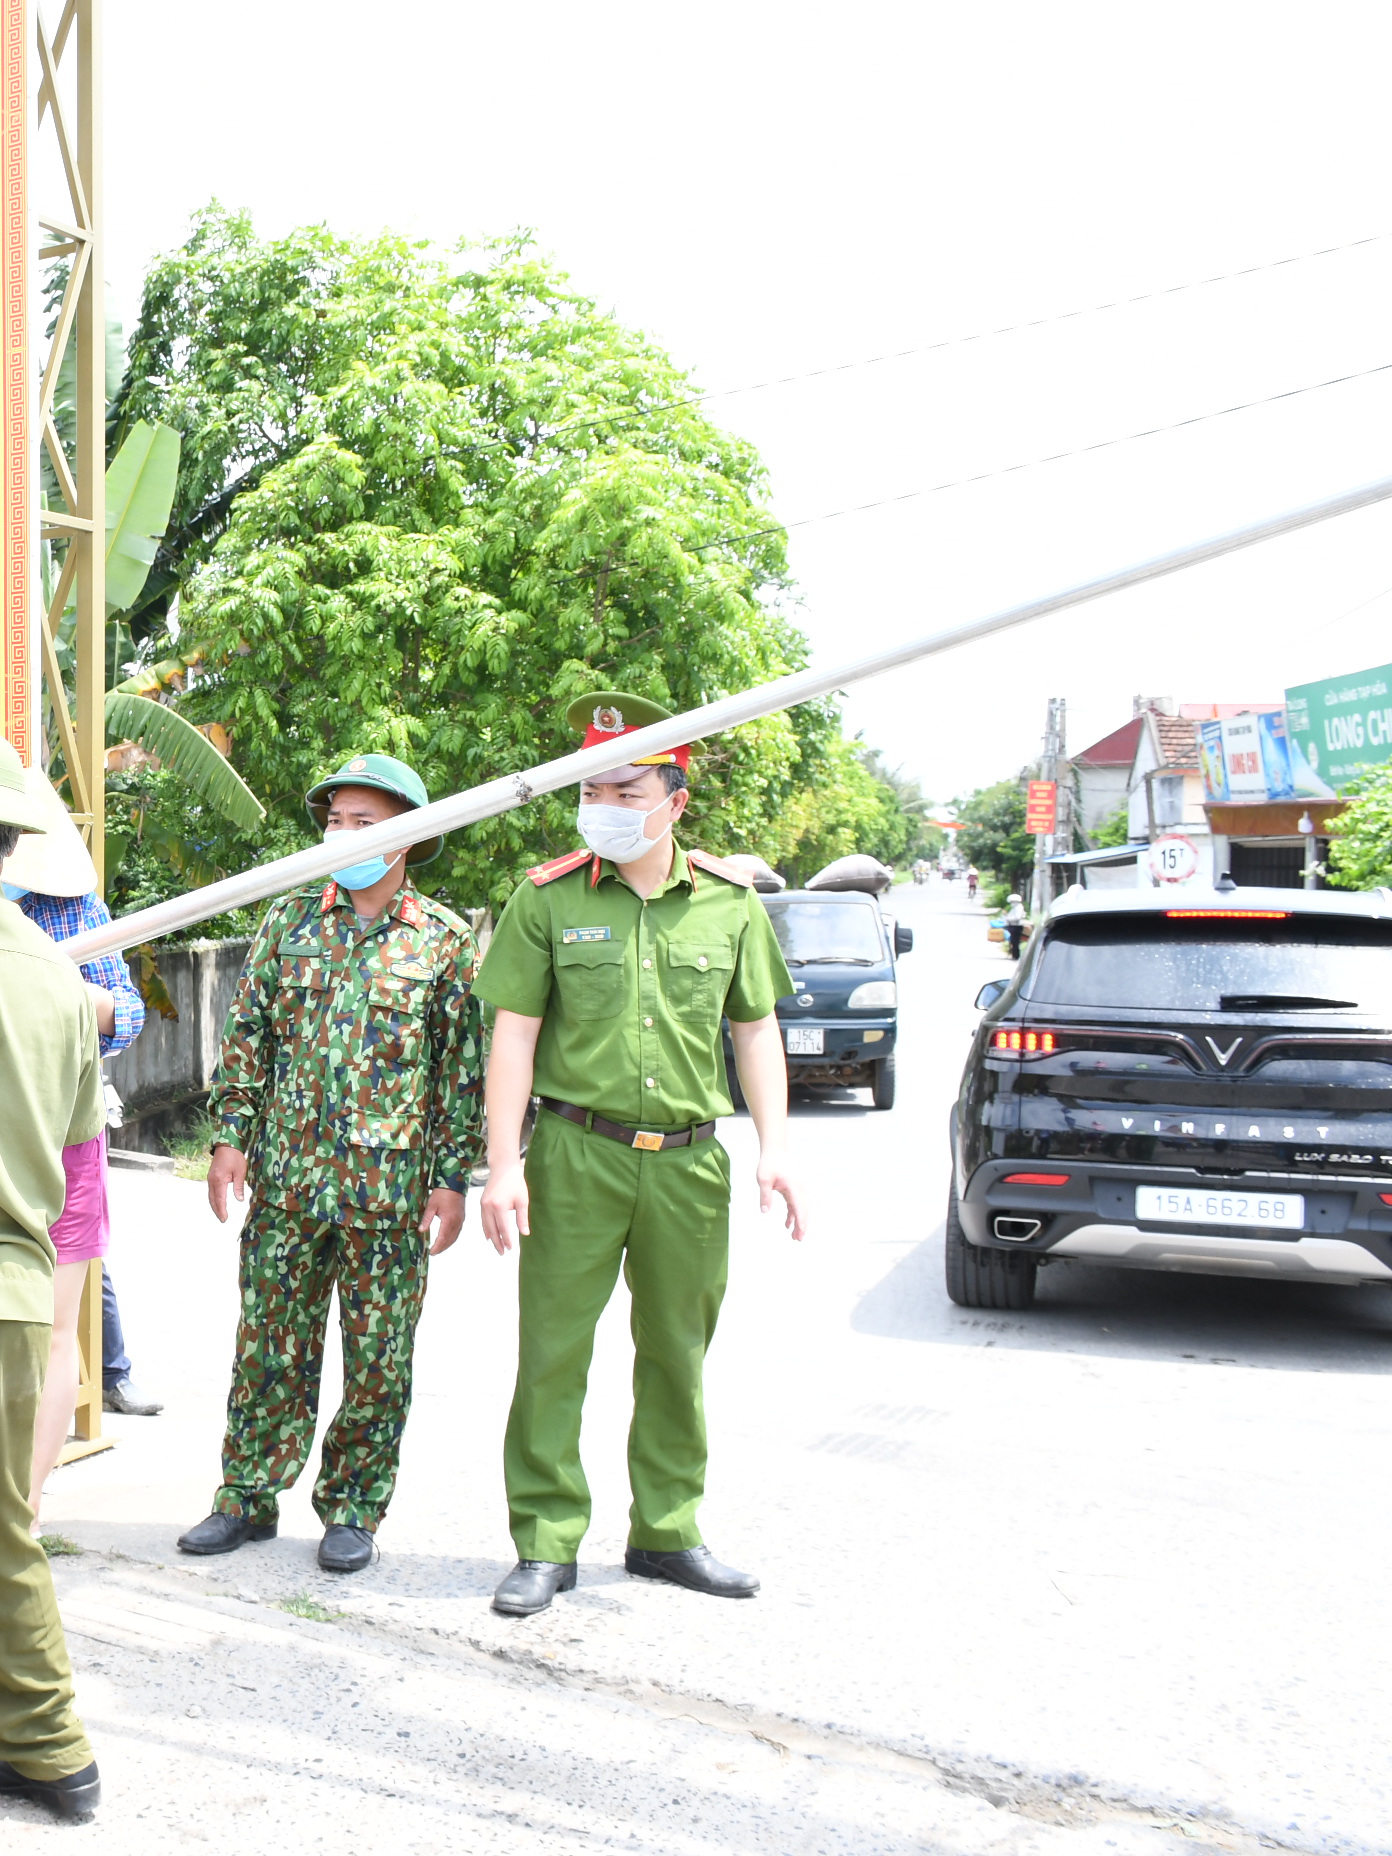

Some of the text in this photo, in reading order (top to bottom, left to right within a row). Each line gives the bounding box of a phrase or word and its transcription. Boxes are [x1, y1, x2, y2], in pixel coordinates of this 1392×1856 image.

[1324, 713, 1365, 751] LONG
[798, 1029, 815, 1041] 15C
[1120, 1117, 1329, 1140] VINFAST
